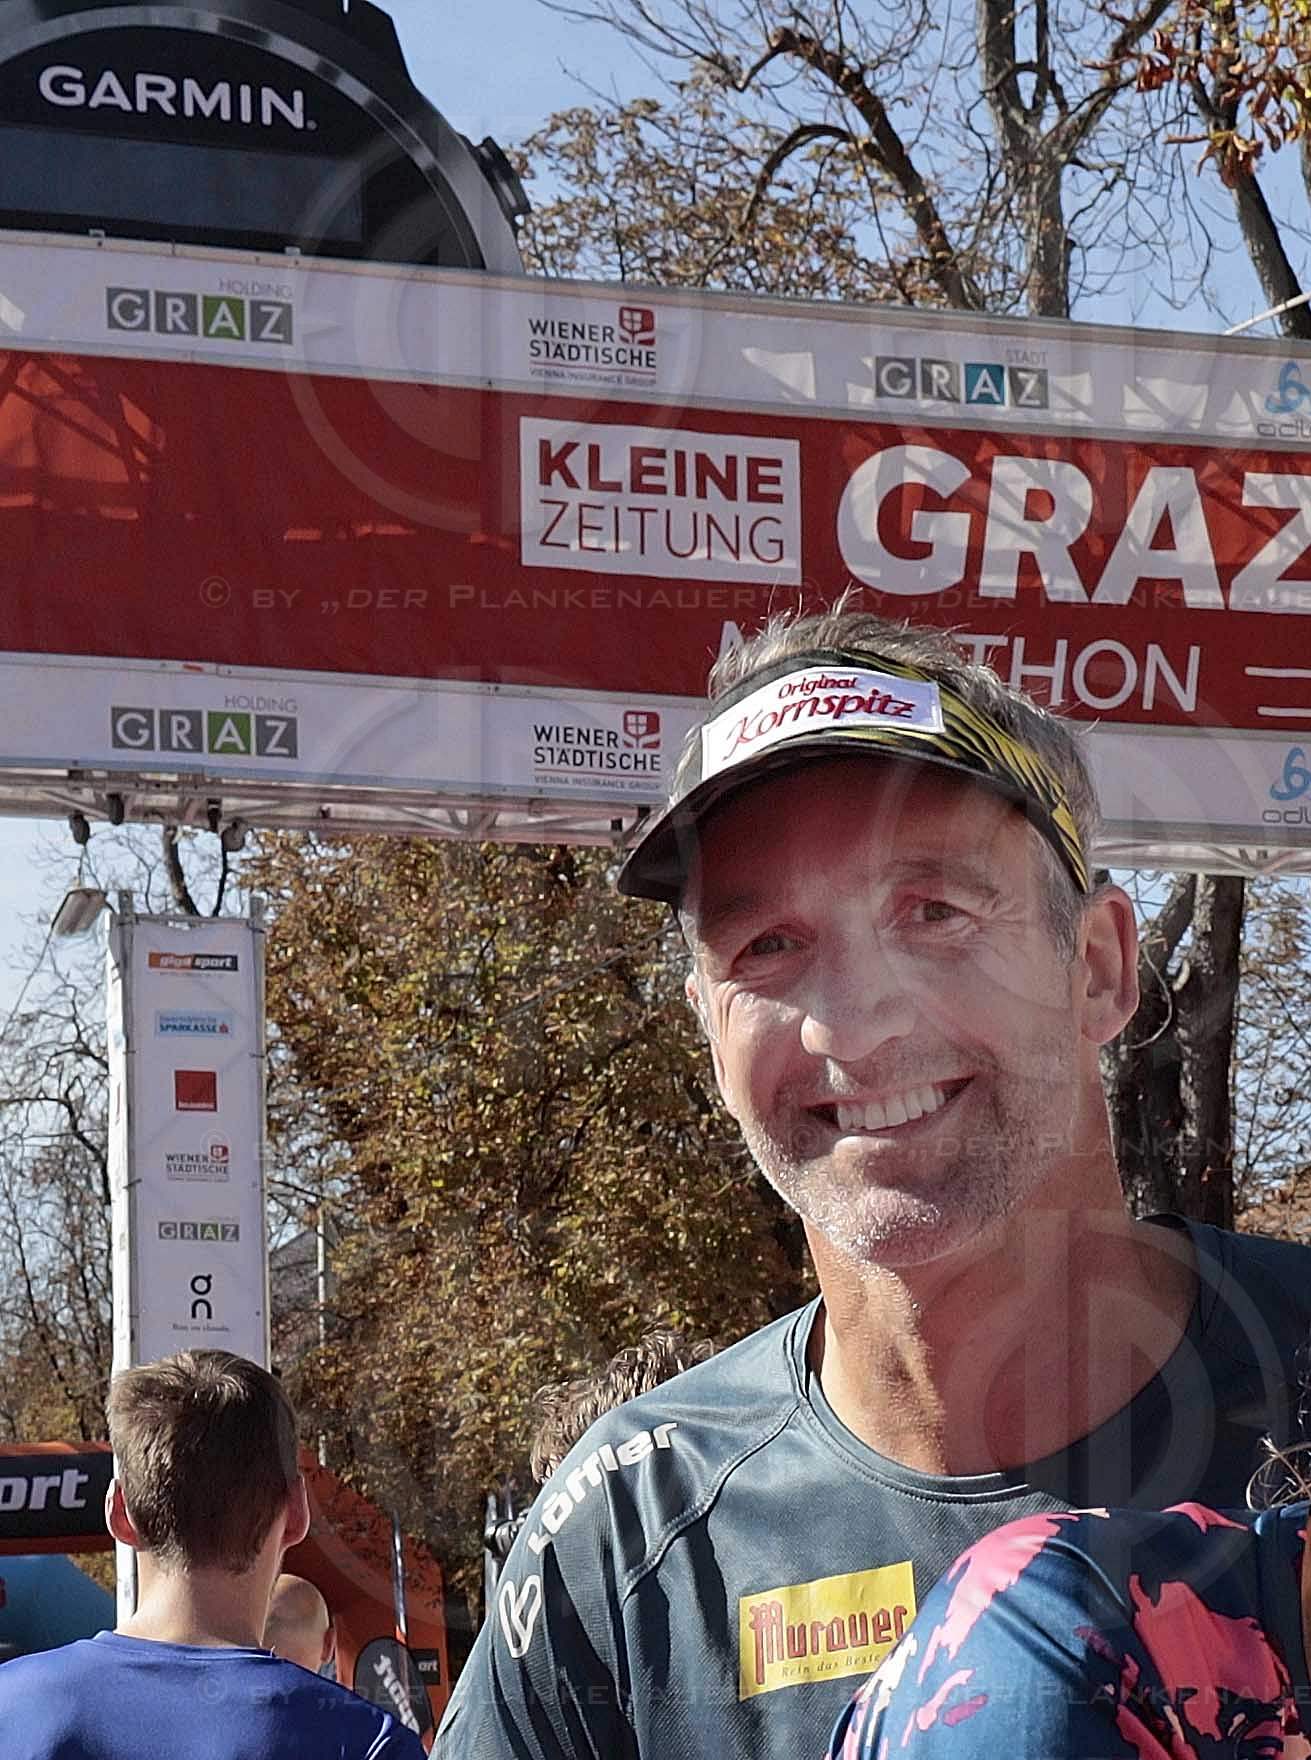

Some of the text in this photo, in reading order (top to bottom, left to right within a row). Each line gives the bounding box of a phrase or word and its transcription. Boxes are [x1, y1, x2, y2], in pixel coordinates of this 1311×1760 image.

[39, 65, 305, 130] GARMIN
[109, 291, 287, 341] GRAZ
[529, 318, 615, 342] WIENER
[529, 339, 657, 368] STÄDTISCHE
[878, 359, 1045, 406] GRAZ
[538, 437, 785, 504] KLEINE
[539, 498, 786, 564] ZEITUNG
[224, 695, 298, 713] HOLDING
[778, 673, 858, 699] Original
[115, 711, 293, 754] GRAZ
[533, 724, 619, 748] WIENER
[723, 688, 917, 761] Kornspitz
[533, 746, 661, 772] STÄDTISCHE
[159, 1222, 239, 1242] GRAZ
[749, 1600, 908, 1686] Murauer
[817, 1660, 839, 1673] das
